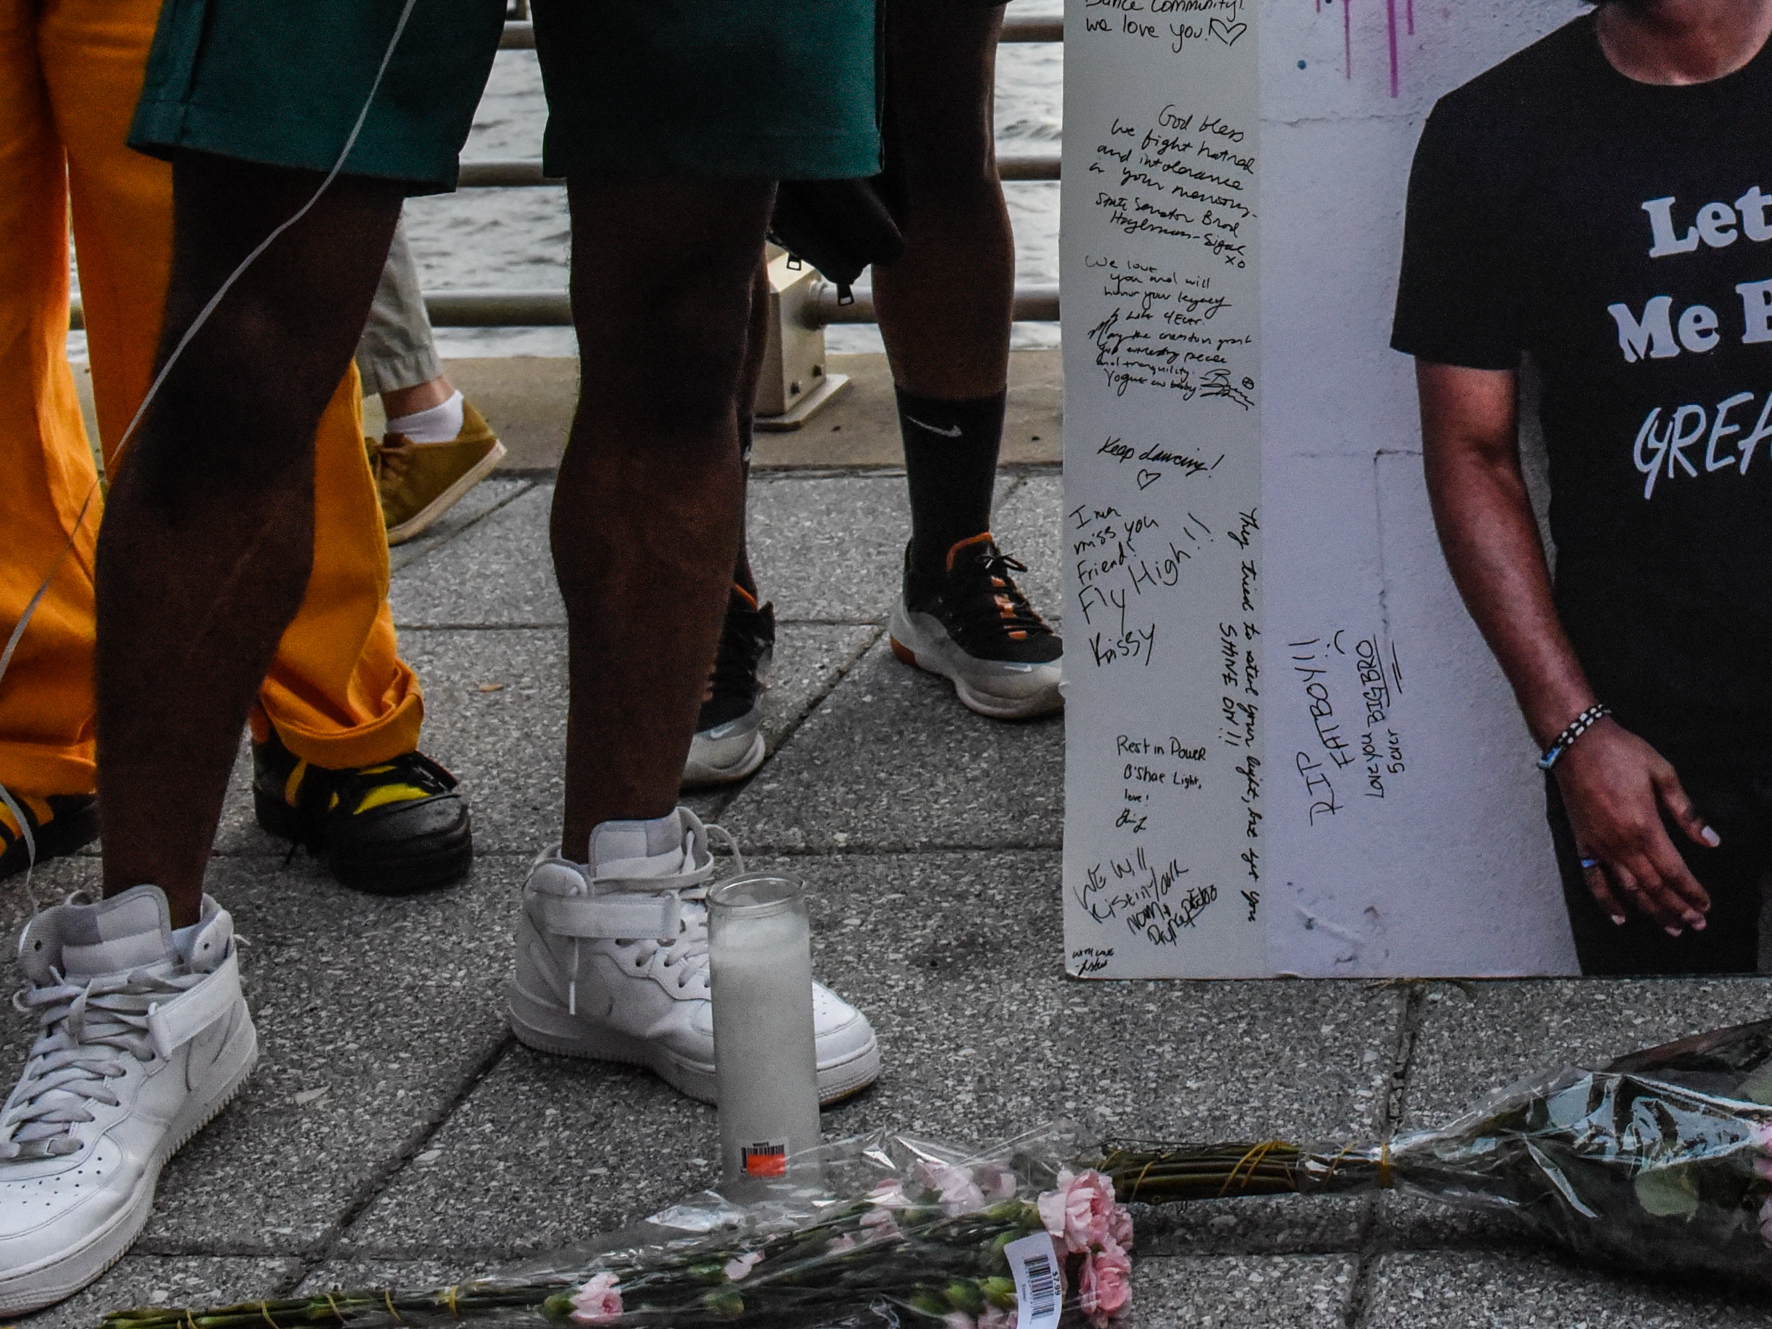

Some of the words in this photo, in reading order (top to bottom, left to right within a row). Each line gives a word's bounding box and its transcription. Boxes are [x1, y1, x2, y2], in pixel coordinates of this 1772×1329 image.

[1123, 14, 1159, 38] love
[1159, 104, 1193, 130] God
[1097, 144, 1132, 162] and
[1141, 129, 1193, 155] fight
[1185, 277, 1210, 289] will
[1607, 296, 1720, 363] Me
[1097, 436, 1135, 463] Keep
[1078, 584, 1125, 636] Fly
[1220, 622, 1238, 687] SHINE
[1116, 735, 1150, 756] Rest
[1154, 745, 1165, 755] in
[1296, 751, 1344, 826] RIP
